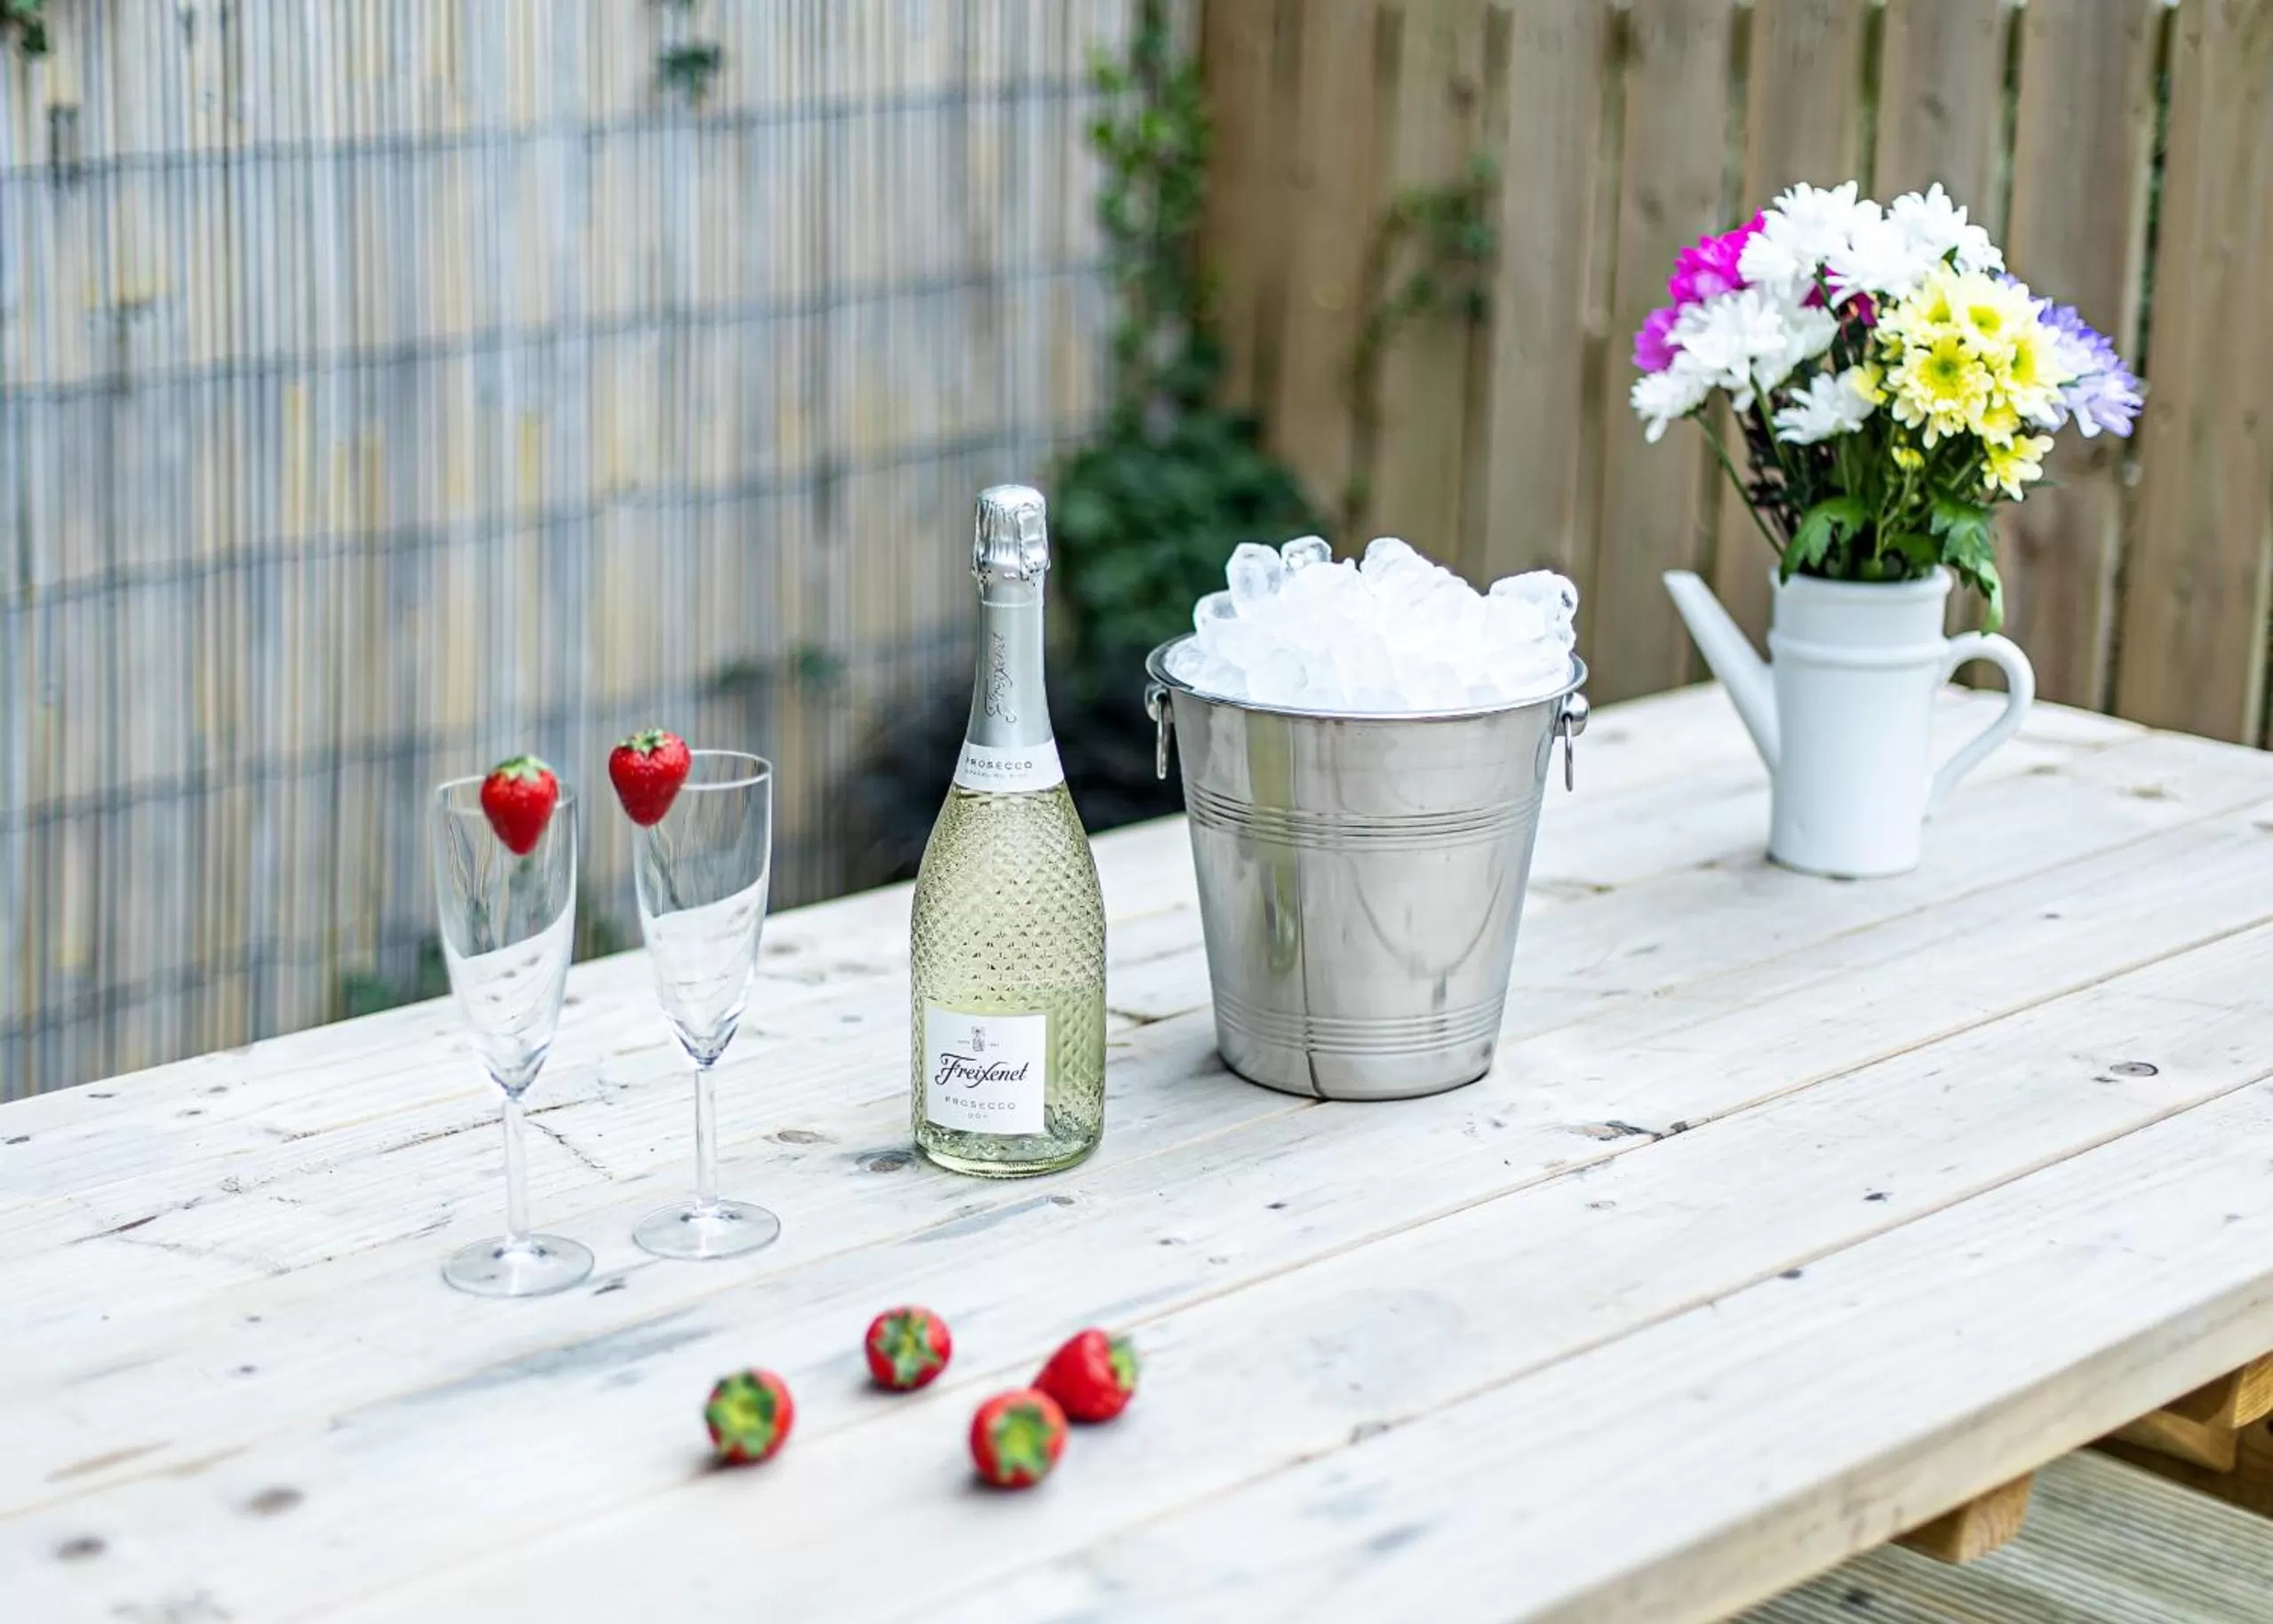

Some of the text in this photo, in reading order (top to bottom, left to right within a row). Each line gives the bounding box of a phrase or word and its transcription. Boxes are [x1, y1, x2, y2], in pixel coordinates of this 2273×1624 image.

[965, 757, 1033, 770] PROSECCO
[935, 1053, 1029, 1088] Freixenet
[945, 1095, 1016, 1110] PROSECCO
